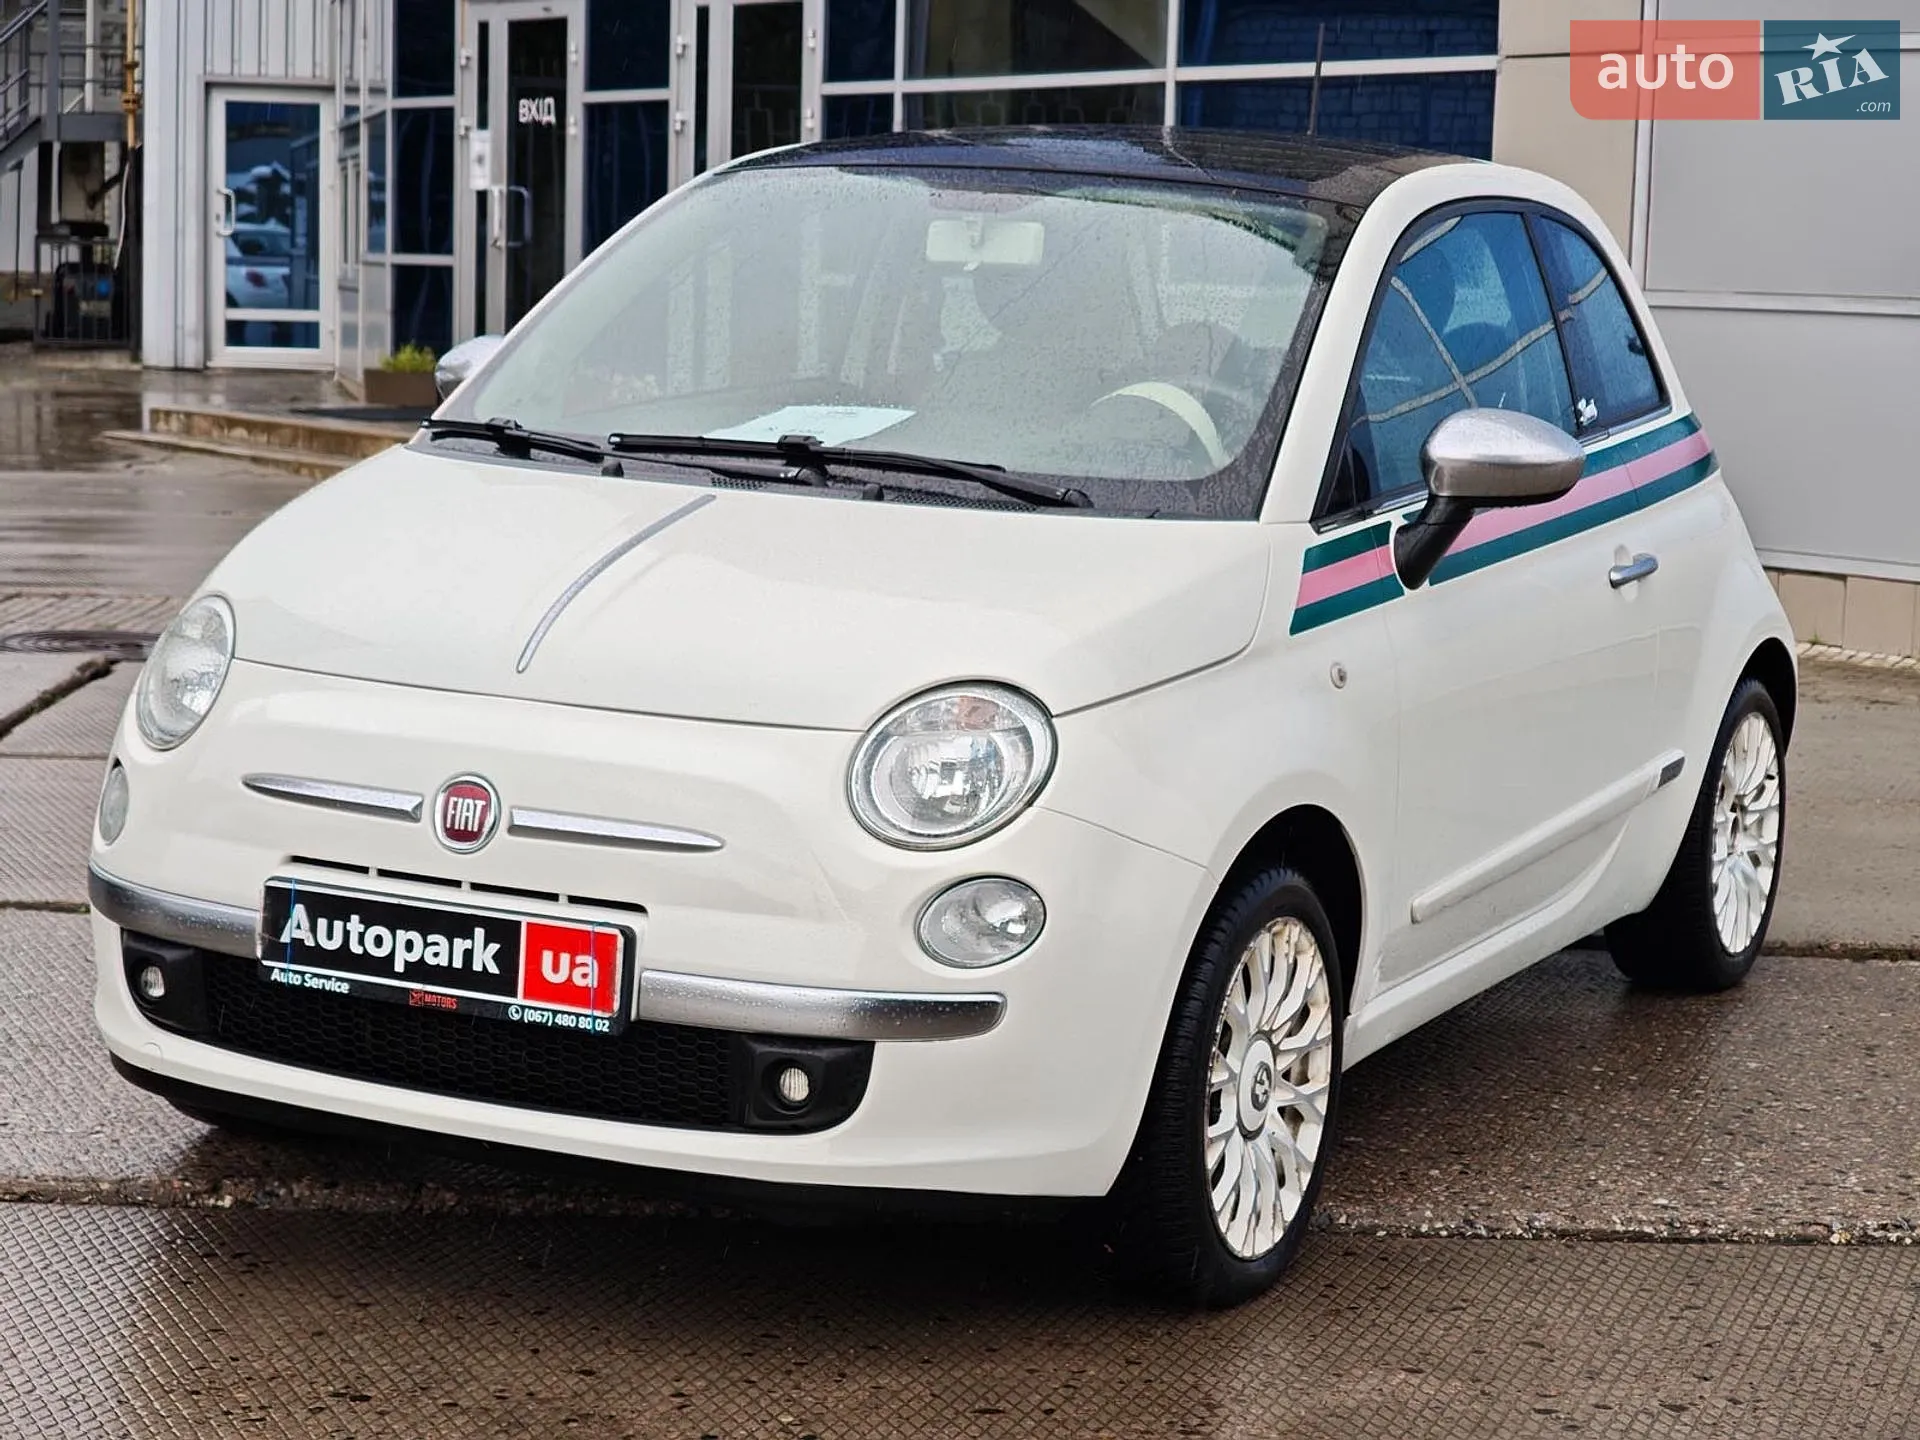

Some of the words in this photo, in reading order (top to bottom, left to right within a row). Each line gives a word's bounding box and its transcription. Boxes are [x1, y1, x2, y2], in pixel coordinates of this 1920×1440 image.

[518, 97, 556, 126] ВХІД
[446, 796, 486, 832] FIAT
[279, 902, 501, 975] Autopark
[541, 949, 599, 990] ua
[270, 968, 302, 986] Auto
[303, 973, 350, 994] Service
[523, 1008, 553, 1026] (067)
[554, 1013, 577, 1028] 480
[578, 1016, 593, 1031] 80
[595, 1019, 610, 1033] 02
